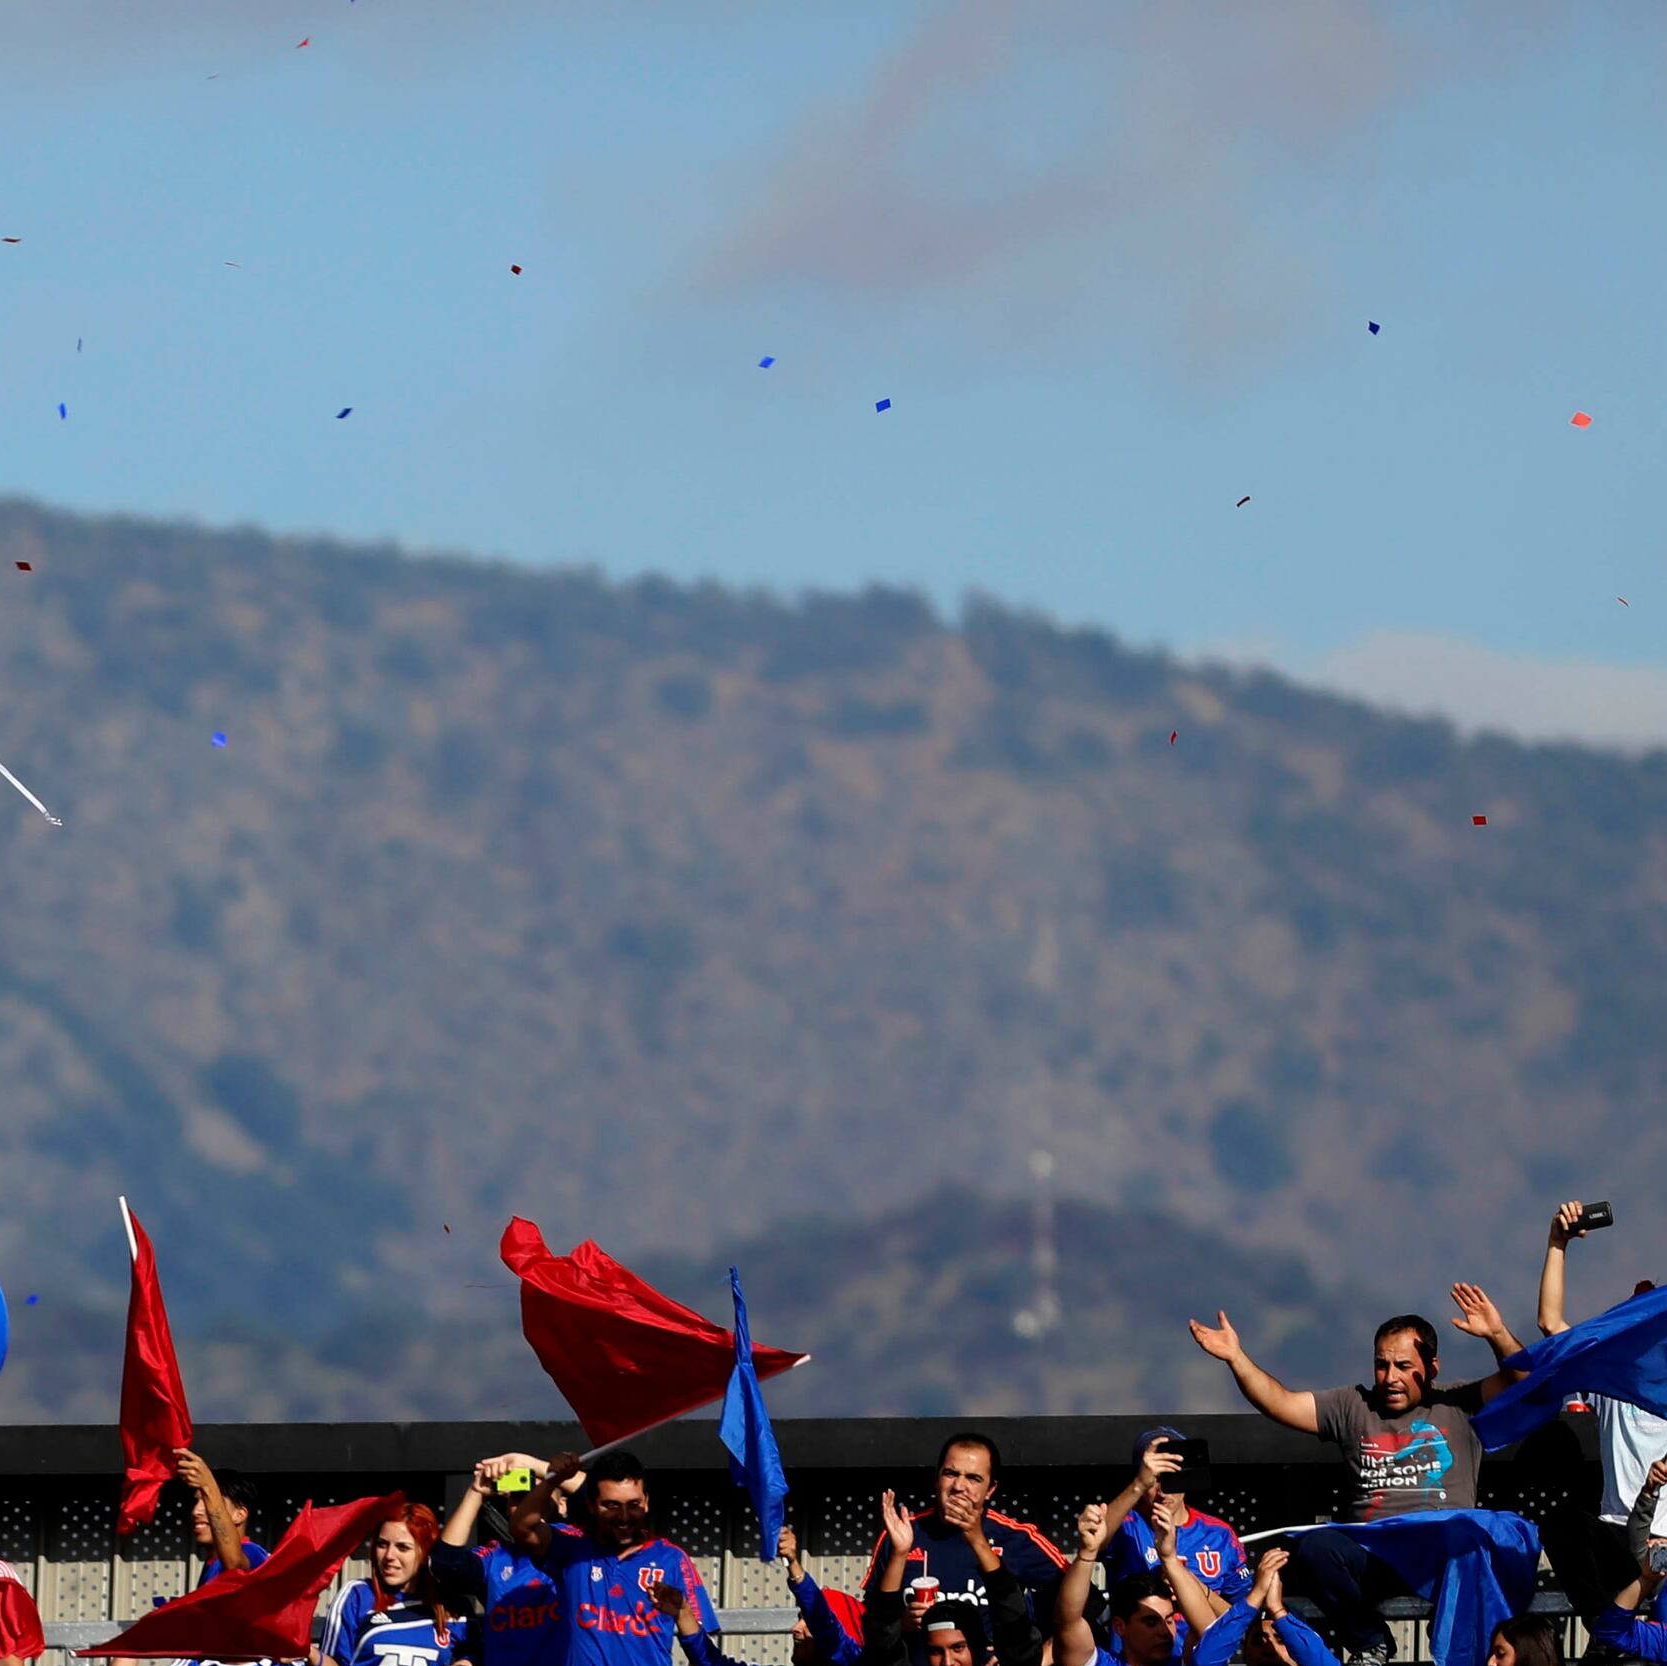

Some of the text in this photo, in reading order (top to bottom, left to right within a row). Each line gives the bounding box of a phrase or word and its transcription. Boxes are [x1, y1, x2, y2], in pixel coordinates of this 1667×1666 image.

[1360, 1454, 1394, 1468] TIME
[1392, 1461, 1442, 1476] SOME
[1196, 1550, 1222, 1579] U
[576, 1602, 648, 1638] Claro
